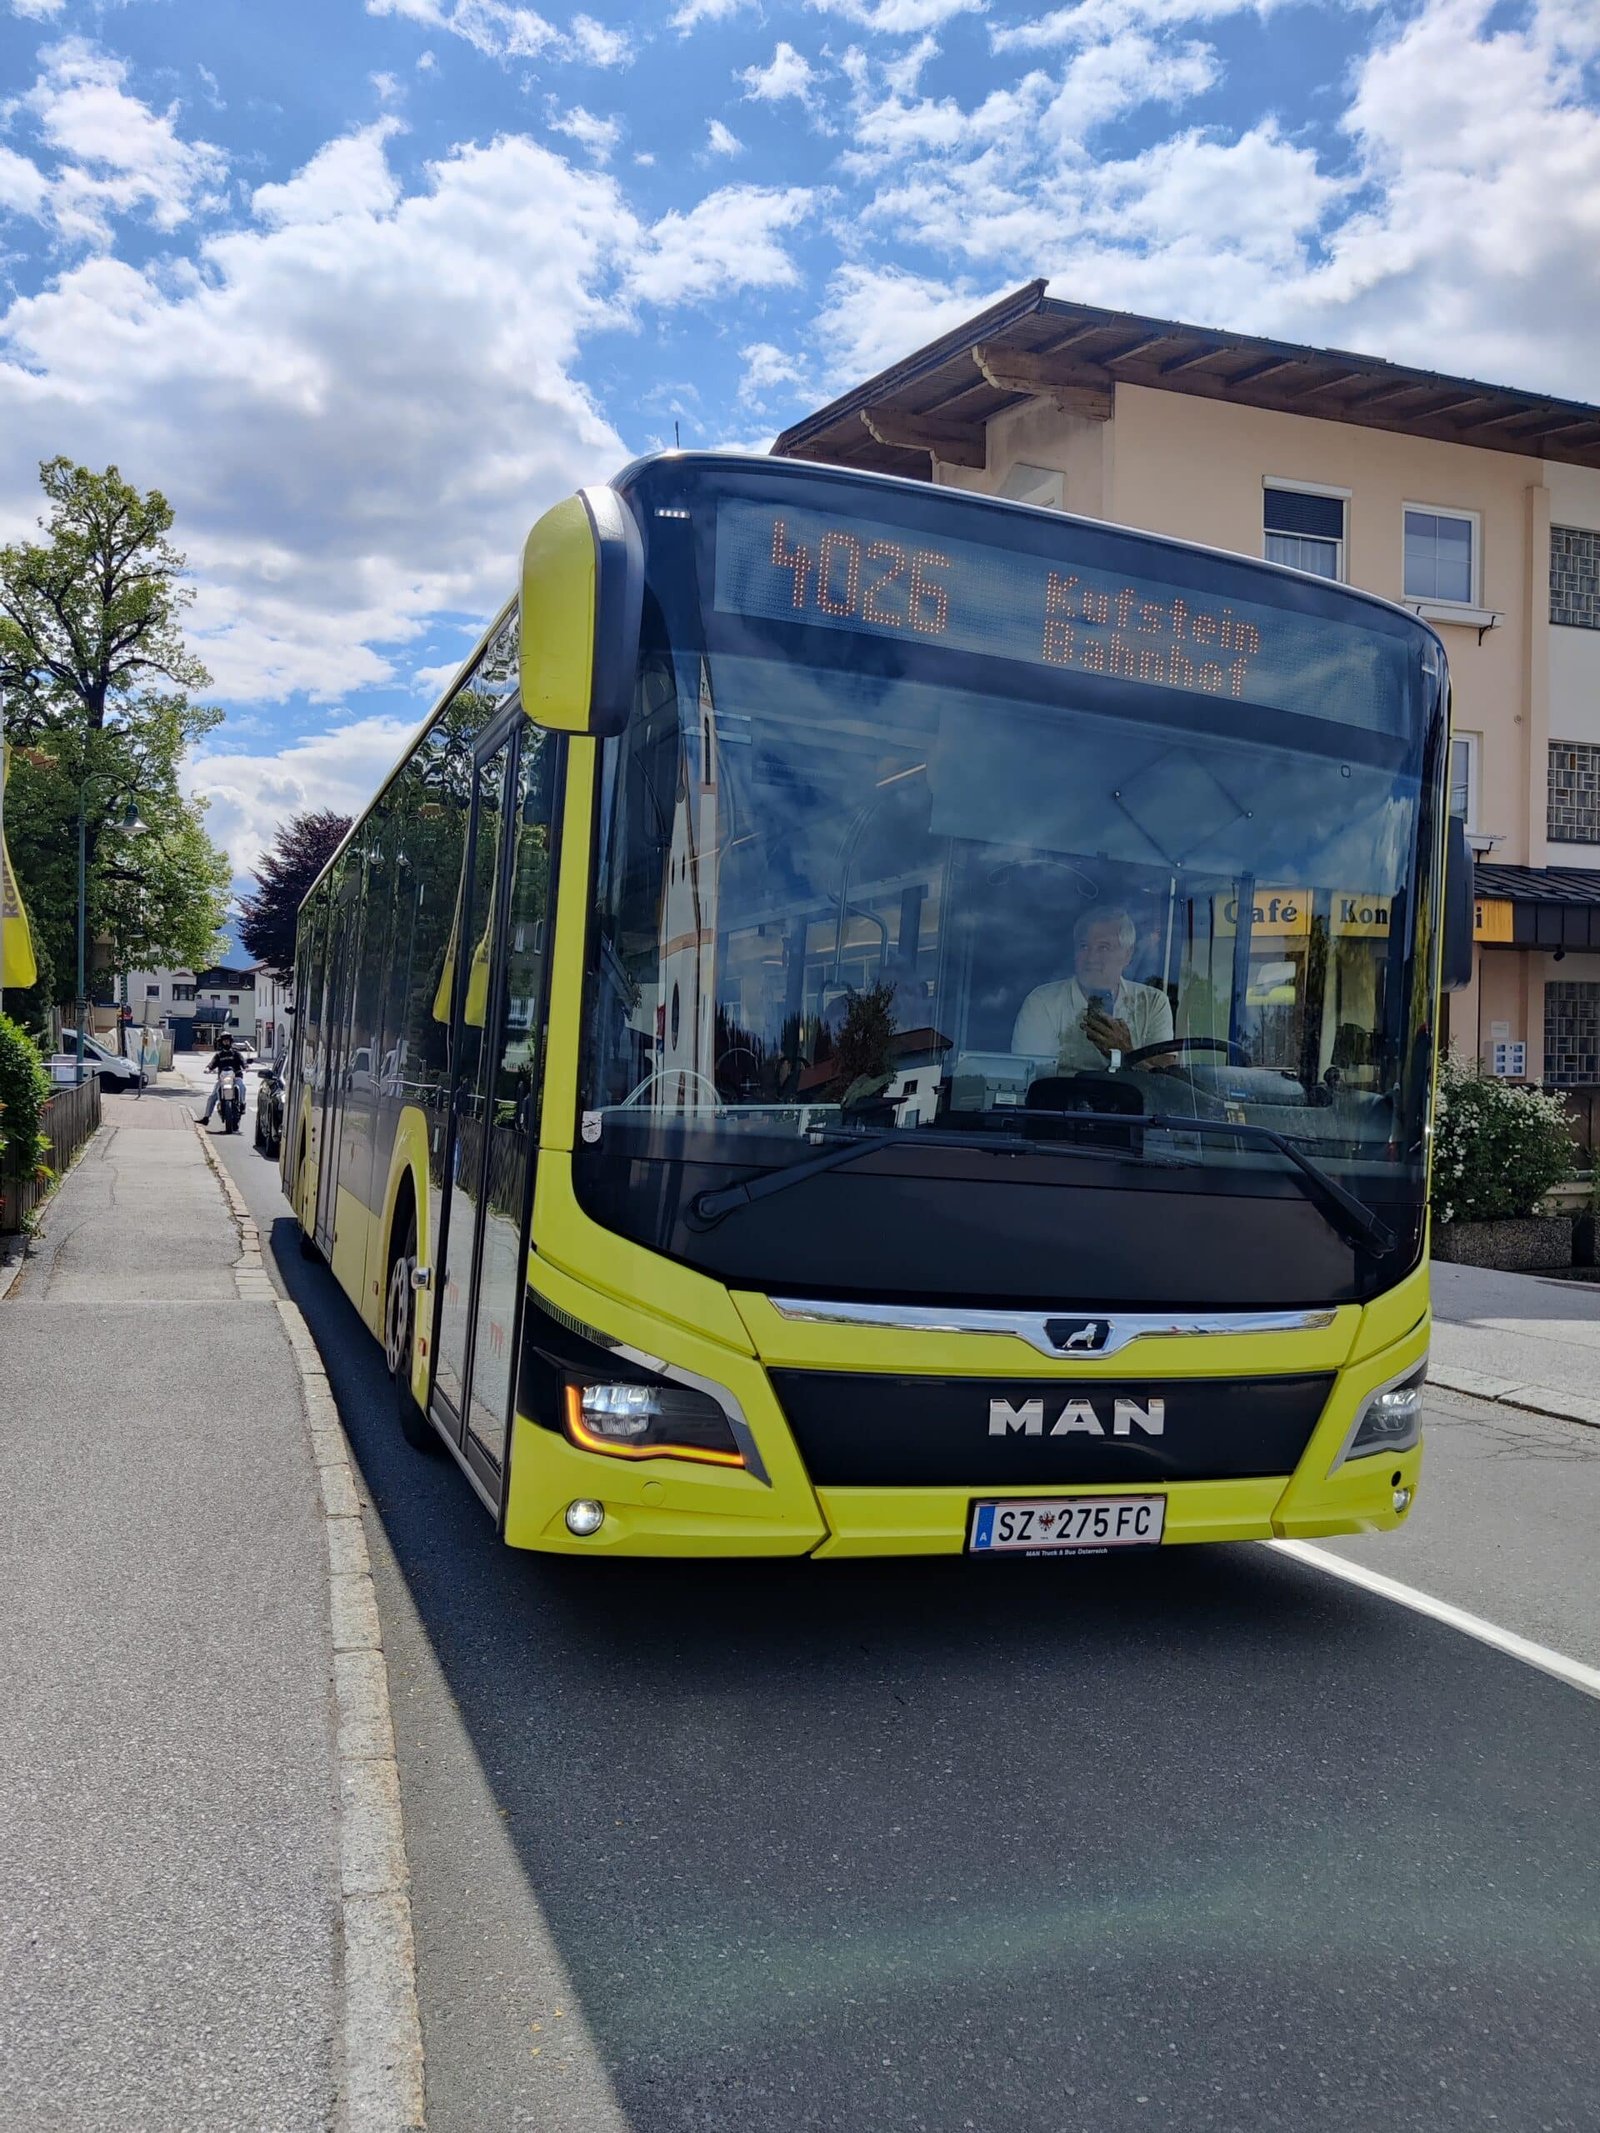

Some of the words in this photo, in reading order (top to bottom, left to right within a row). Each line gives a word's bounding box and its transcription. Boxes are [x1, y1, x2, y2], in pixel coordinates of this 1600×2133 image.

[771, 520, 951, 634] 4026
[1045, 571, 1260, 654] Kufstein
[1042, 619, 1249, 697] Bahnhof
[1224, 898, 1298, 924] Café
[988, 1398, 1166, 1436] MAN
[979, 1531, 988, 1542] A
[998, 1510, 1036, 1542] SZ
